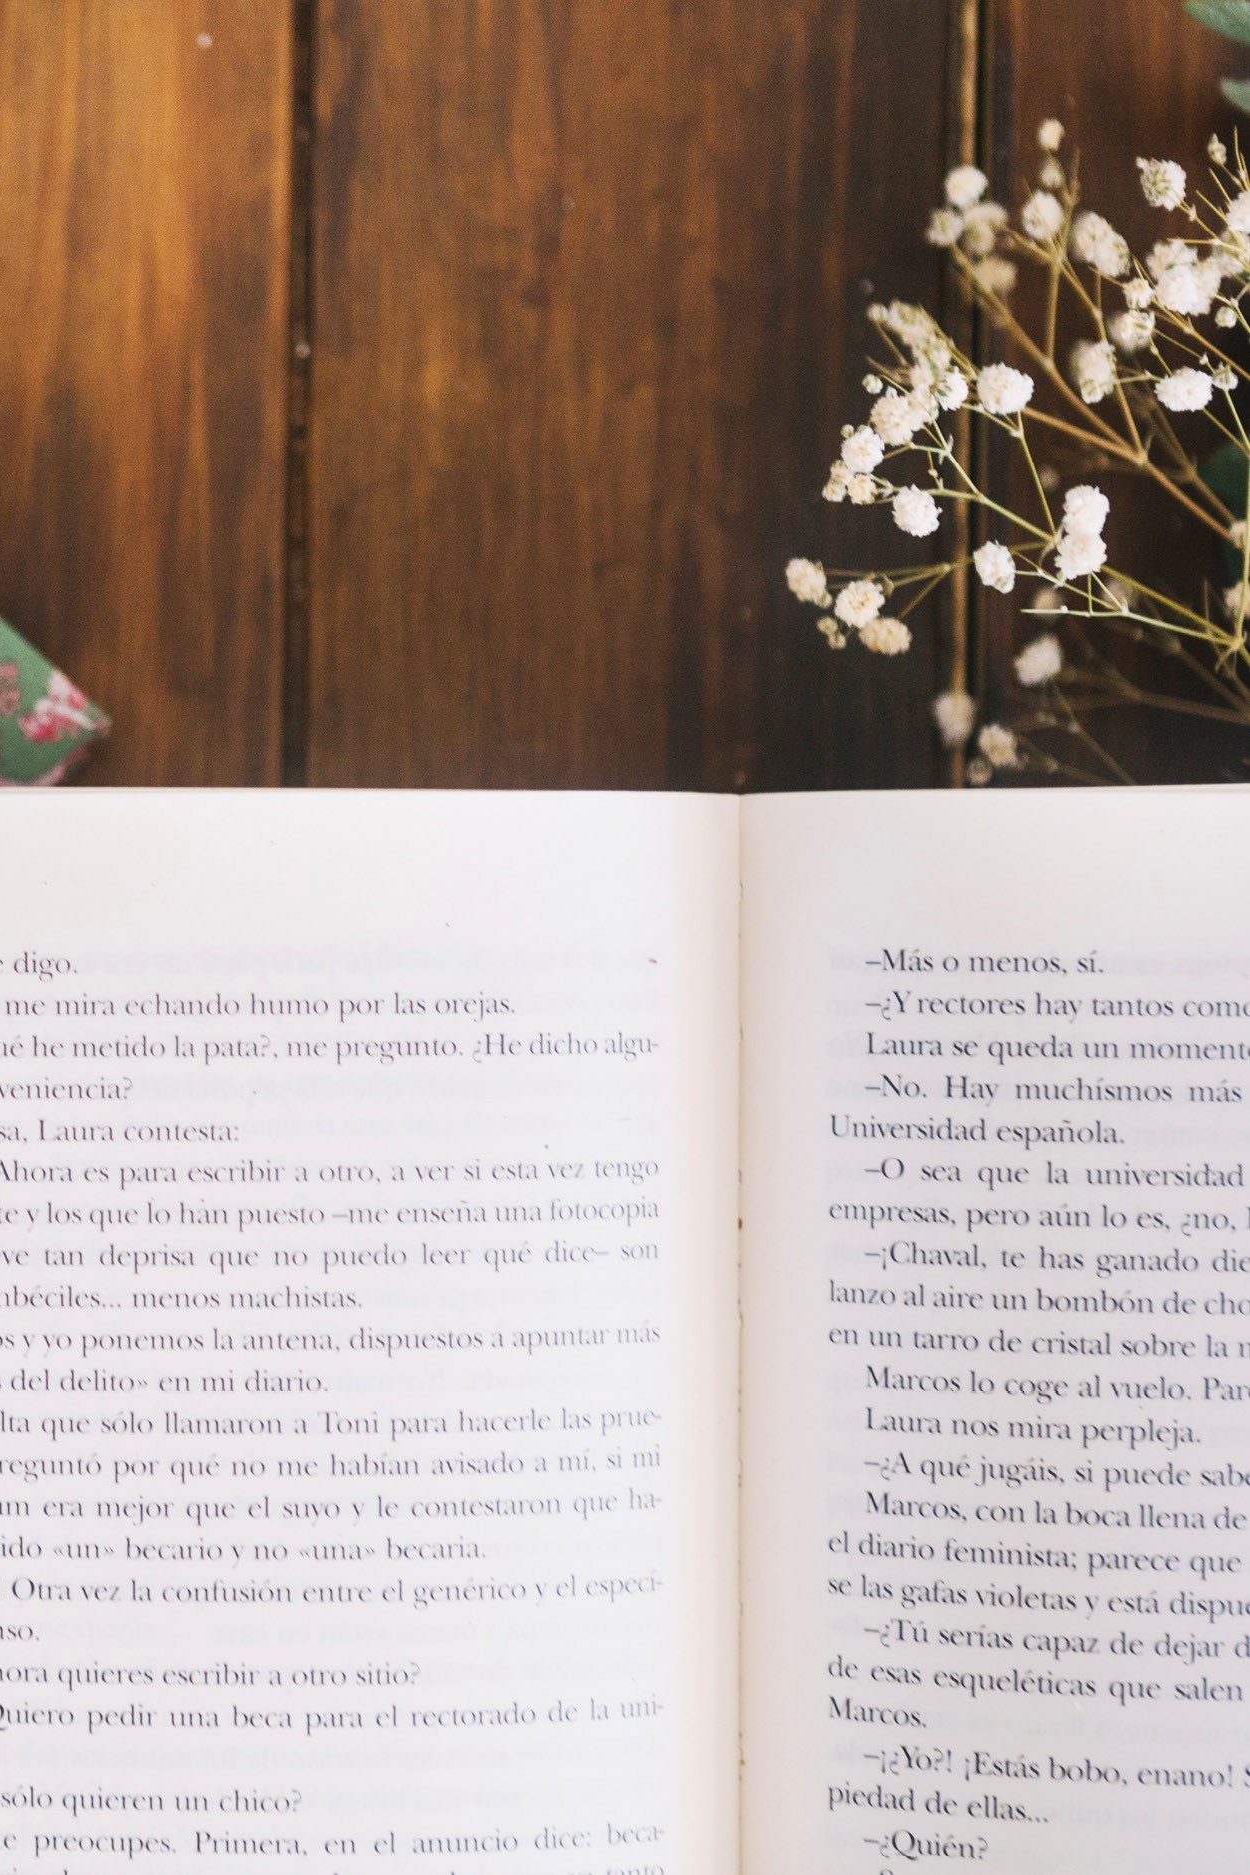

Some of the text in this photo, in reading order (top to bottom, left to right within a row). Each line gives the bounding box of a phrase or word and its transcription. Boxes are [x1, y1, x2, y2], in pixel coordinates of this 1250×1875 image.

[12, 950, 78, 983] digo.
[941, 955, 960, 973] o
[968, 955, 1068, 976] menos,
[1076, 949, 1105, 974] sí.
[4, 999, 47, 1017] me
[54, 992, 116, 1016] mira
[124, 991, 241, 1017] echando
[250, 992, 330, 1016] humo
[338, 998, 386, 1024] por
[393, 991, 427, 1016] las
[434, 991, 516, 1023] orejas.
[916, 995, 1027, 1016] rectores
[1034, 991, 1083, 1024] hay
[1091, 997, 1175, 1017] tantos
[31, 1034, 65, 1058] he
[72, 1034, 166, 1059] metido
[173, 1034, 196, 1059] la
[202, 1033, 279, 1067] pata?,
[287, 1040, 328, 1058] me
[335, 1038, 464, 1066] pregunto.
[472, 1032, 523, 1064] ¿He
[528, 1031, 599, 1056] dicho
[866, 1031, 1120, 1066] Laura se queda un
[944, 1074, 1000, 1108] Hay
[1014, 1076, 1173, 1103] muchísmos
[1188, 1079, 1243, 1104] más
[37, 1118, 115, 1143] Laura
[122, 1120, 239, 1143] contesta:
[829, 1113, 1125, 1152] Universidad española.
[920, 1164, 963, 1183] sea
[977, 1166, 1030, 1192] que
[1045, 1160, 1070, 1185] la
[1085, 1161, 1245, 1188] universidad
[1000, 1249, 1026, 1269] te
[1038, 1244, 1085, 1271] has
[1095, 1247, 1200, 1279] ganado
[132, 1291, 221, 1309] menos
[229, 1285, 363, 1309] machistas.
[829, 1278, 897, 1306] lanzo
[902, 1283, 926, 1308] al
[932, 1284, 984, 1310] aire
[991, 1293, 1028, 1311] un
[1035, 1287, 1155, 1314] bombón
[1161, 1290, 1197, 1315] de
[21, 1333, 36, 1359] y
[41, 1333, 73, 1359] yo
[80, 1333, 205, 1359] ponemos
[212, 1327, 234, 1351] la
[242, 1332, 341, 1353] antena,
[348, 1326, 484, 1359] dispuestos
[490, 1332, 505, 1349] a
[512, 1327, 608, 1356] apuntar
[616, 1319, 661, 1344] más
[9, 1367, 51, 1392] del
[158, 1376, 191, 1392] en
[201, 1369, 235, 1392] mi
[244, 1368, 329, 1392] diario.
[40, 1417, 91, 1443] que
[100, 1410, 154, 1435] sólo
[164, 1410, 283, 1435] llamaron
[293, 1417, 308, 1435] a
[317, 1410, 379, 1435] Toni
[389, 1417, 448, 1443] para
[458, 1407, 551, 1433] hacerle
[561, 1407, 592, 1430] las
[865, 1406, 1202, 1452] Laura nos mira perpleja.
[865, 1490, 1248, 1531] Marcos, con la boca llena de
[125, 1535, 224, 1561] becario
[230, 1544, 245, 1569] y
[253, 1544, 289, 1561] no
[385, 1535, 486, 1560] becaria.
[827, 1529, 1242, 1582] el diario feminista; parece que
[937, 1623, 1014, 1650] serías
[1021, 1633, 1100, 1661] capaz
[1109, 1630, 1145, 1656] de
[1153, 1632, 1226, 1666] dejar
[57, 1660, 154, 1693] quieres
[161, 1661, 261, 1687] escribir
[268, 1669, 283, 1687] a
[291, 1667, 348, 1687] otro
[355, 1661, 421, 1686] sitio?
[827, 1653, 1244, 1707] de esas esqueléticas que salen
[828, 1695, 928, 1729] Marcos.
[964, 1750, 1041, 1783] ¡Estás
[1047, 1755, 1128, 1787] bobo,
[1136, 1763, 1233, 1788] enano!
[0, 1784, 54, 1809] sólo
[61, 1786, 164, 1819] quieren
[174, 1795, 209, 1812] un
[218, 1788, 303, 1813] chico?
[827, 1780, 916, 1812] piedad
[923, 1789, 959, 1817] de
